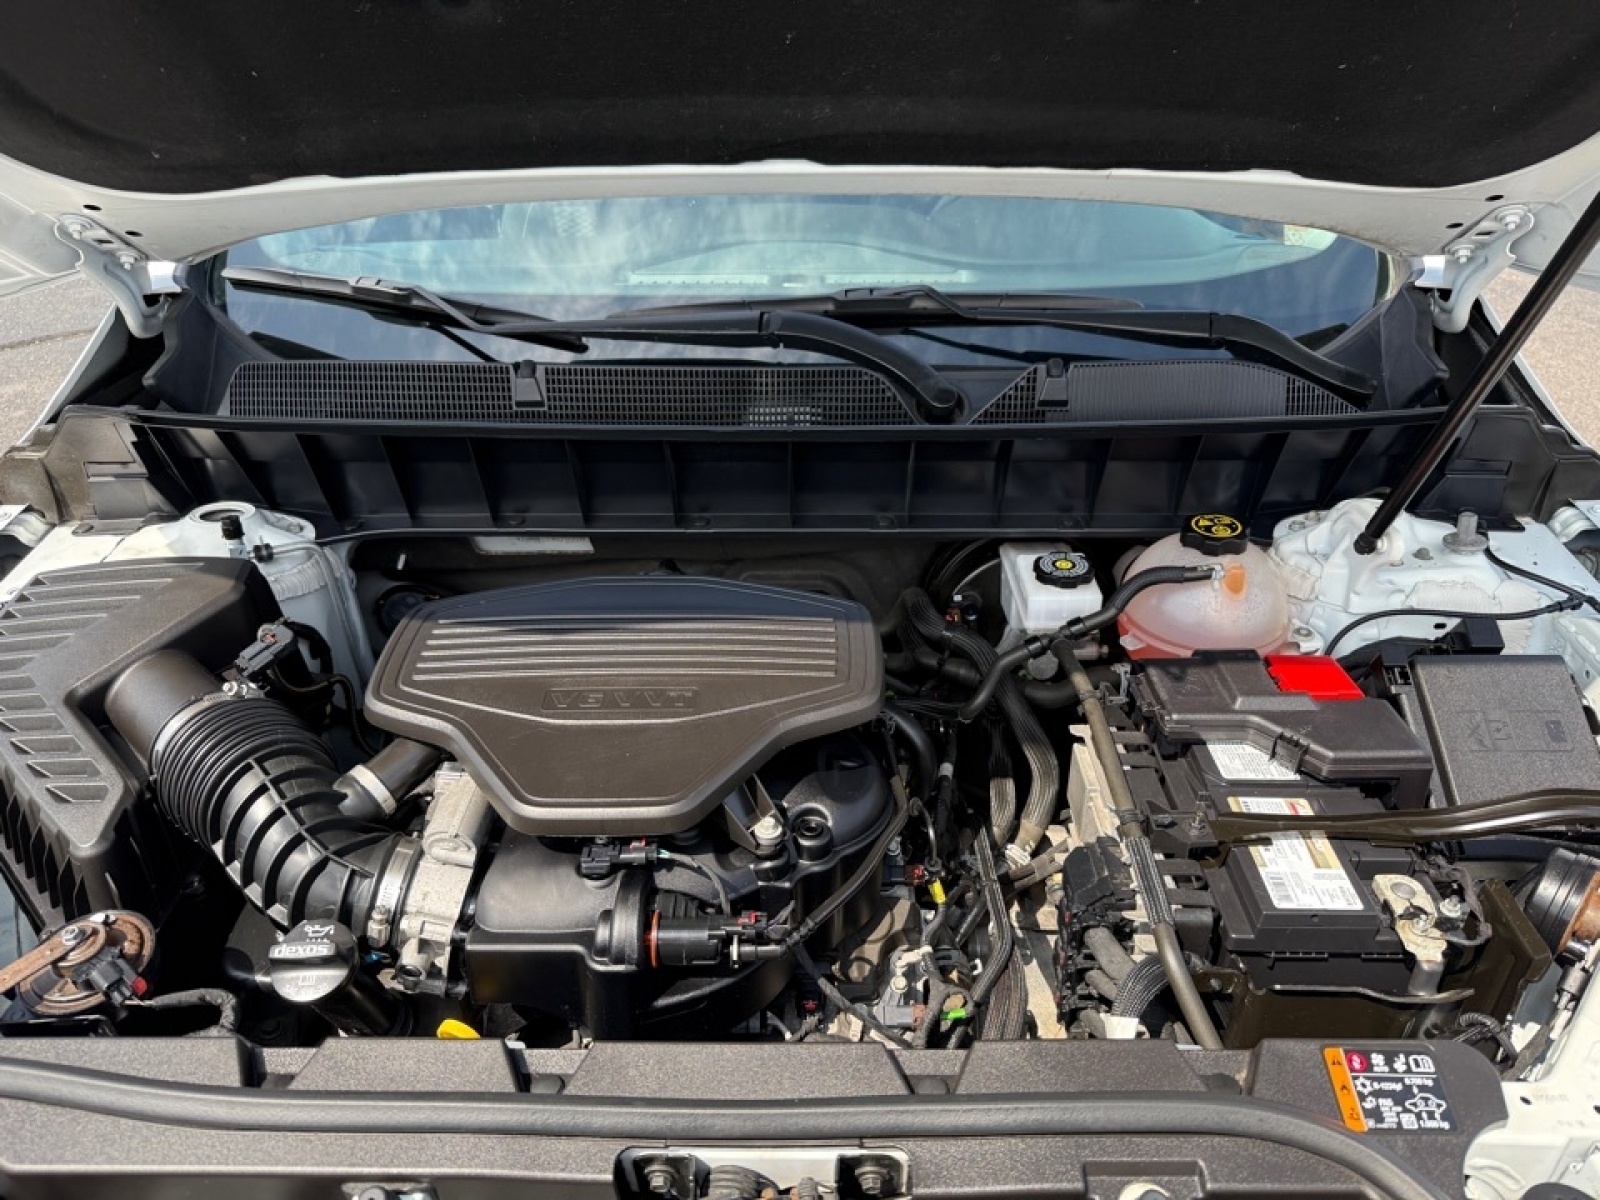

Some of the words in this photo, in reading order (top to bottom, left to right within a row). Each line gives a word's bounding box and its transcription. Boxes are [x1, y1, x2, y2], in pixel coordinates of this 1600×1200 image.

[551, 691, 604, 708] V6
[614, 690, 693, 707] VVT
[274, 944, 331, 957] dexos
